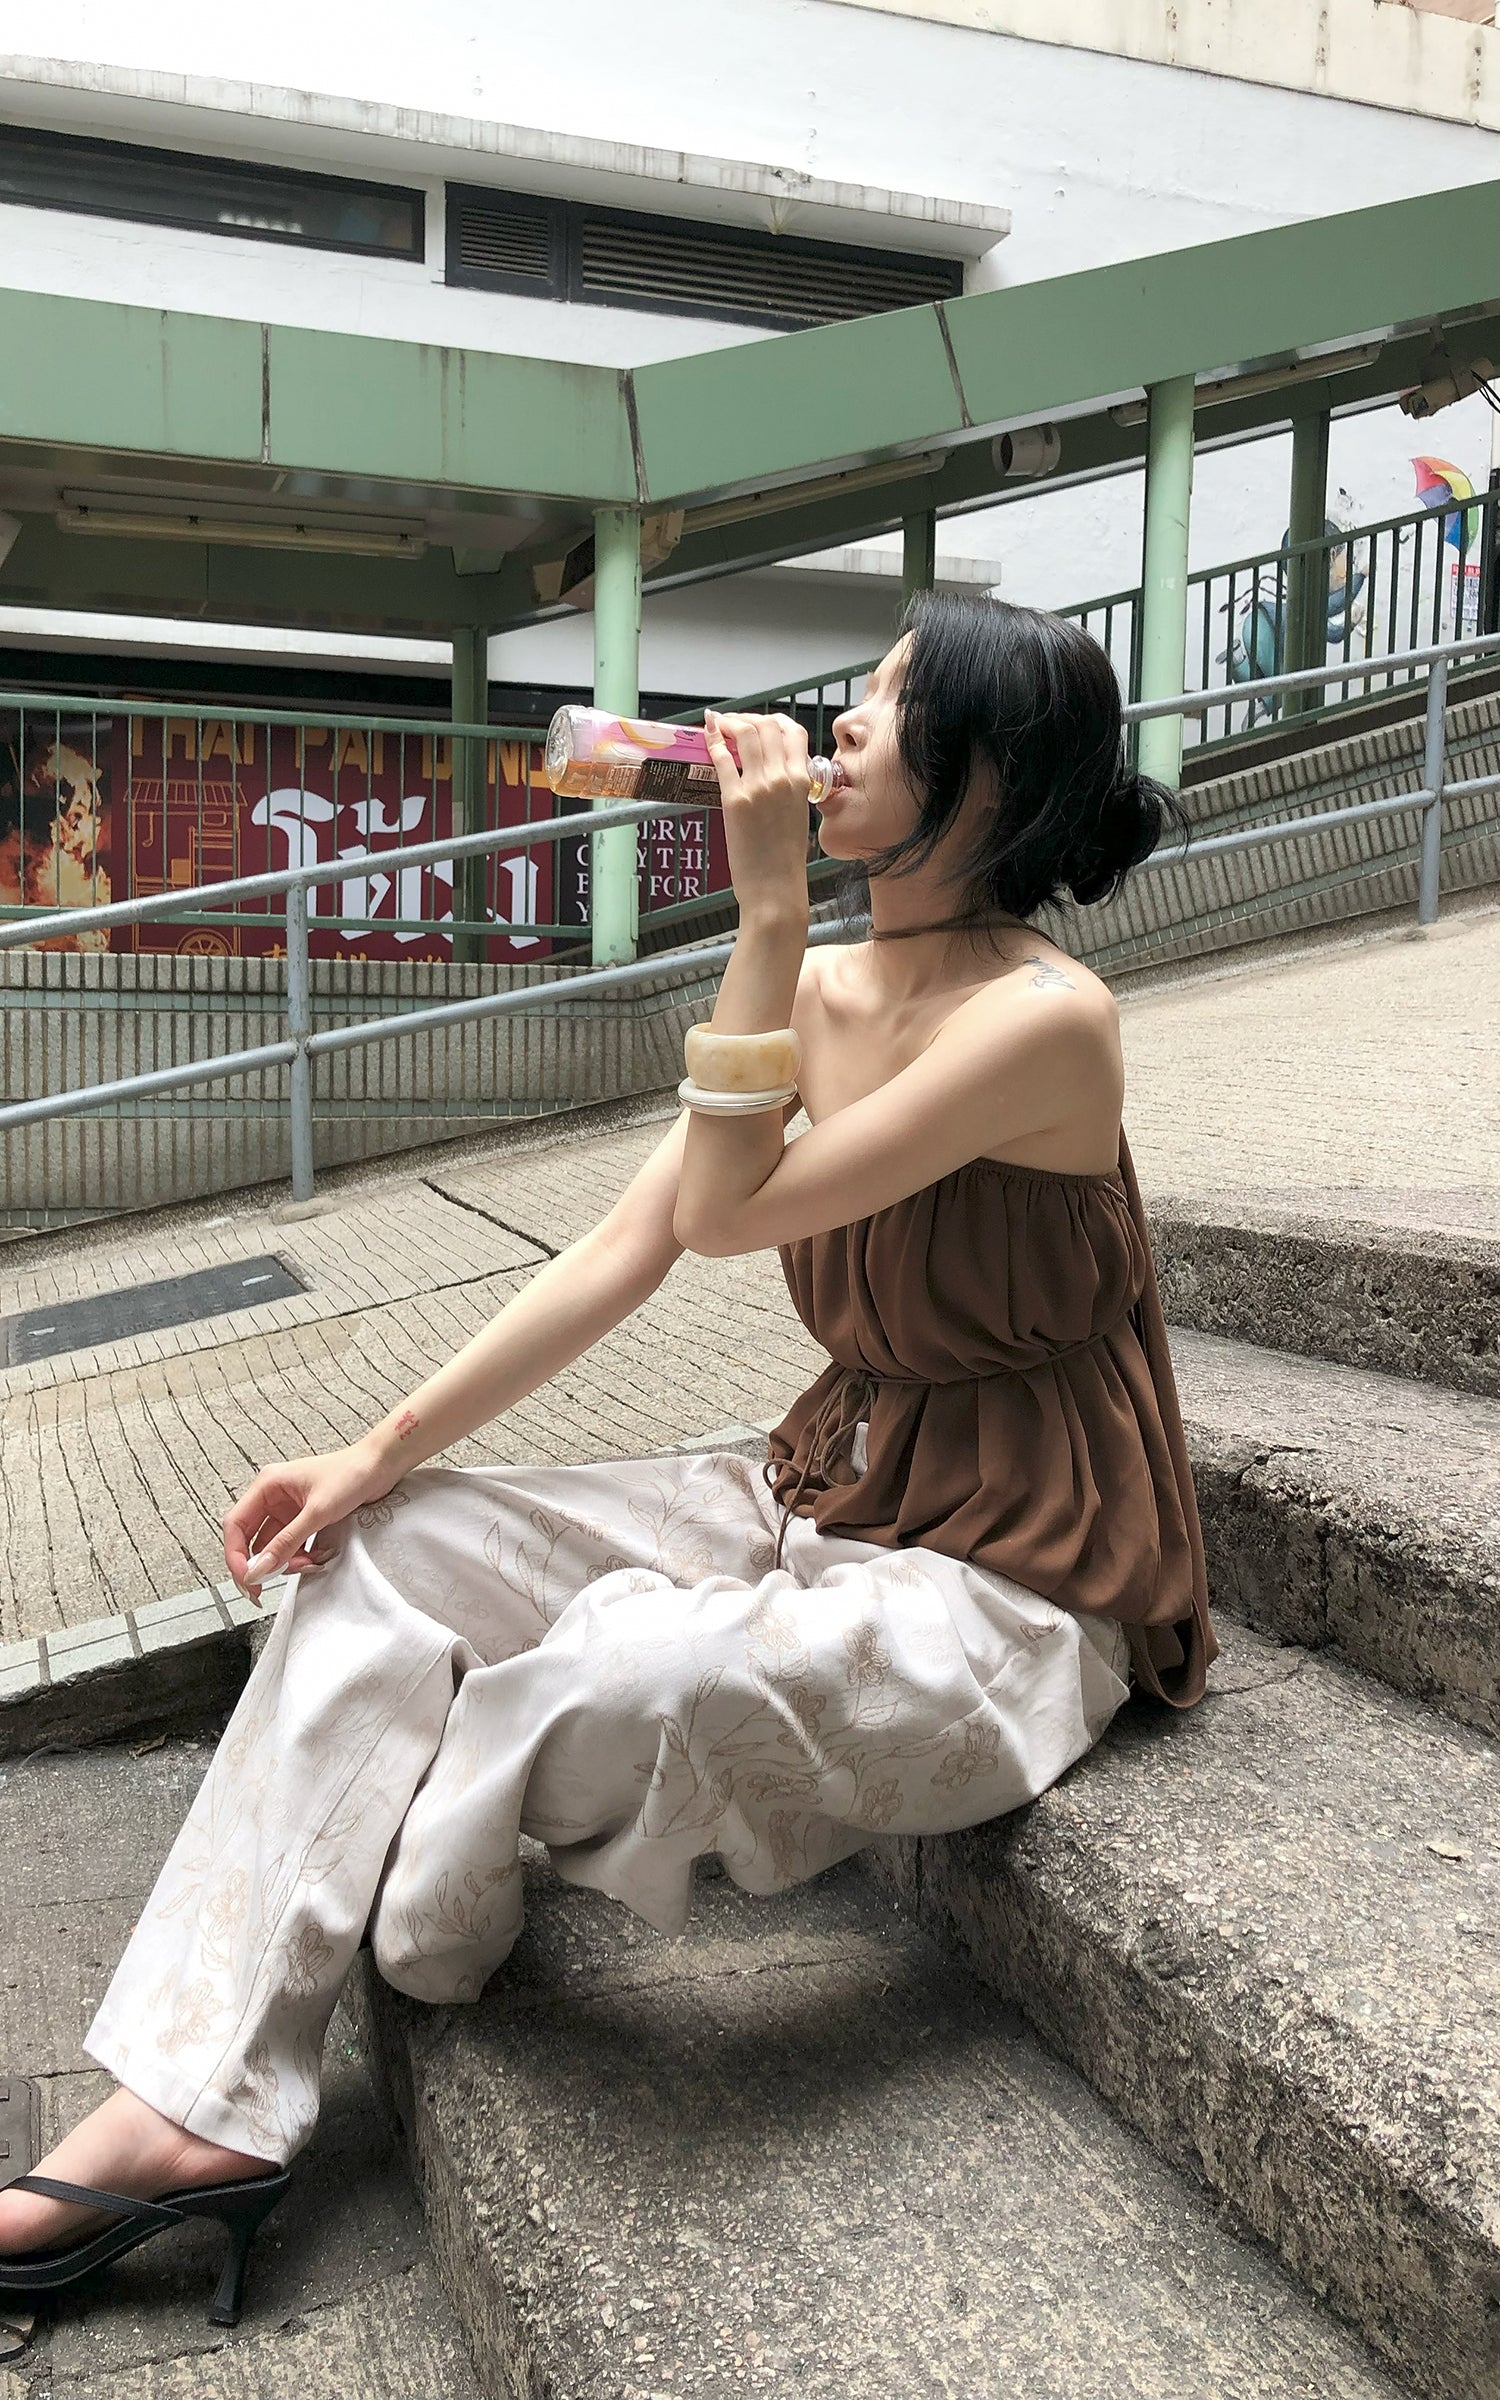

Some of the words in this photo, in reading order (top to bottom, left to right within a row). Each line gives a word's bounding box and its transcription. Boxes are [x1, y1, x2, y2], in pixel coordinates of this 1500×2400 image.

[636, 818, 704, 842] ERVE
[657, 847, 710, 870] THE
[650, 875, 700, 898] FOR
